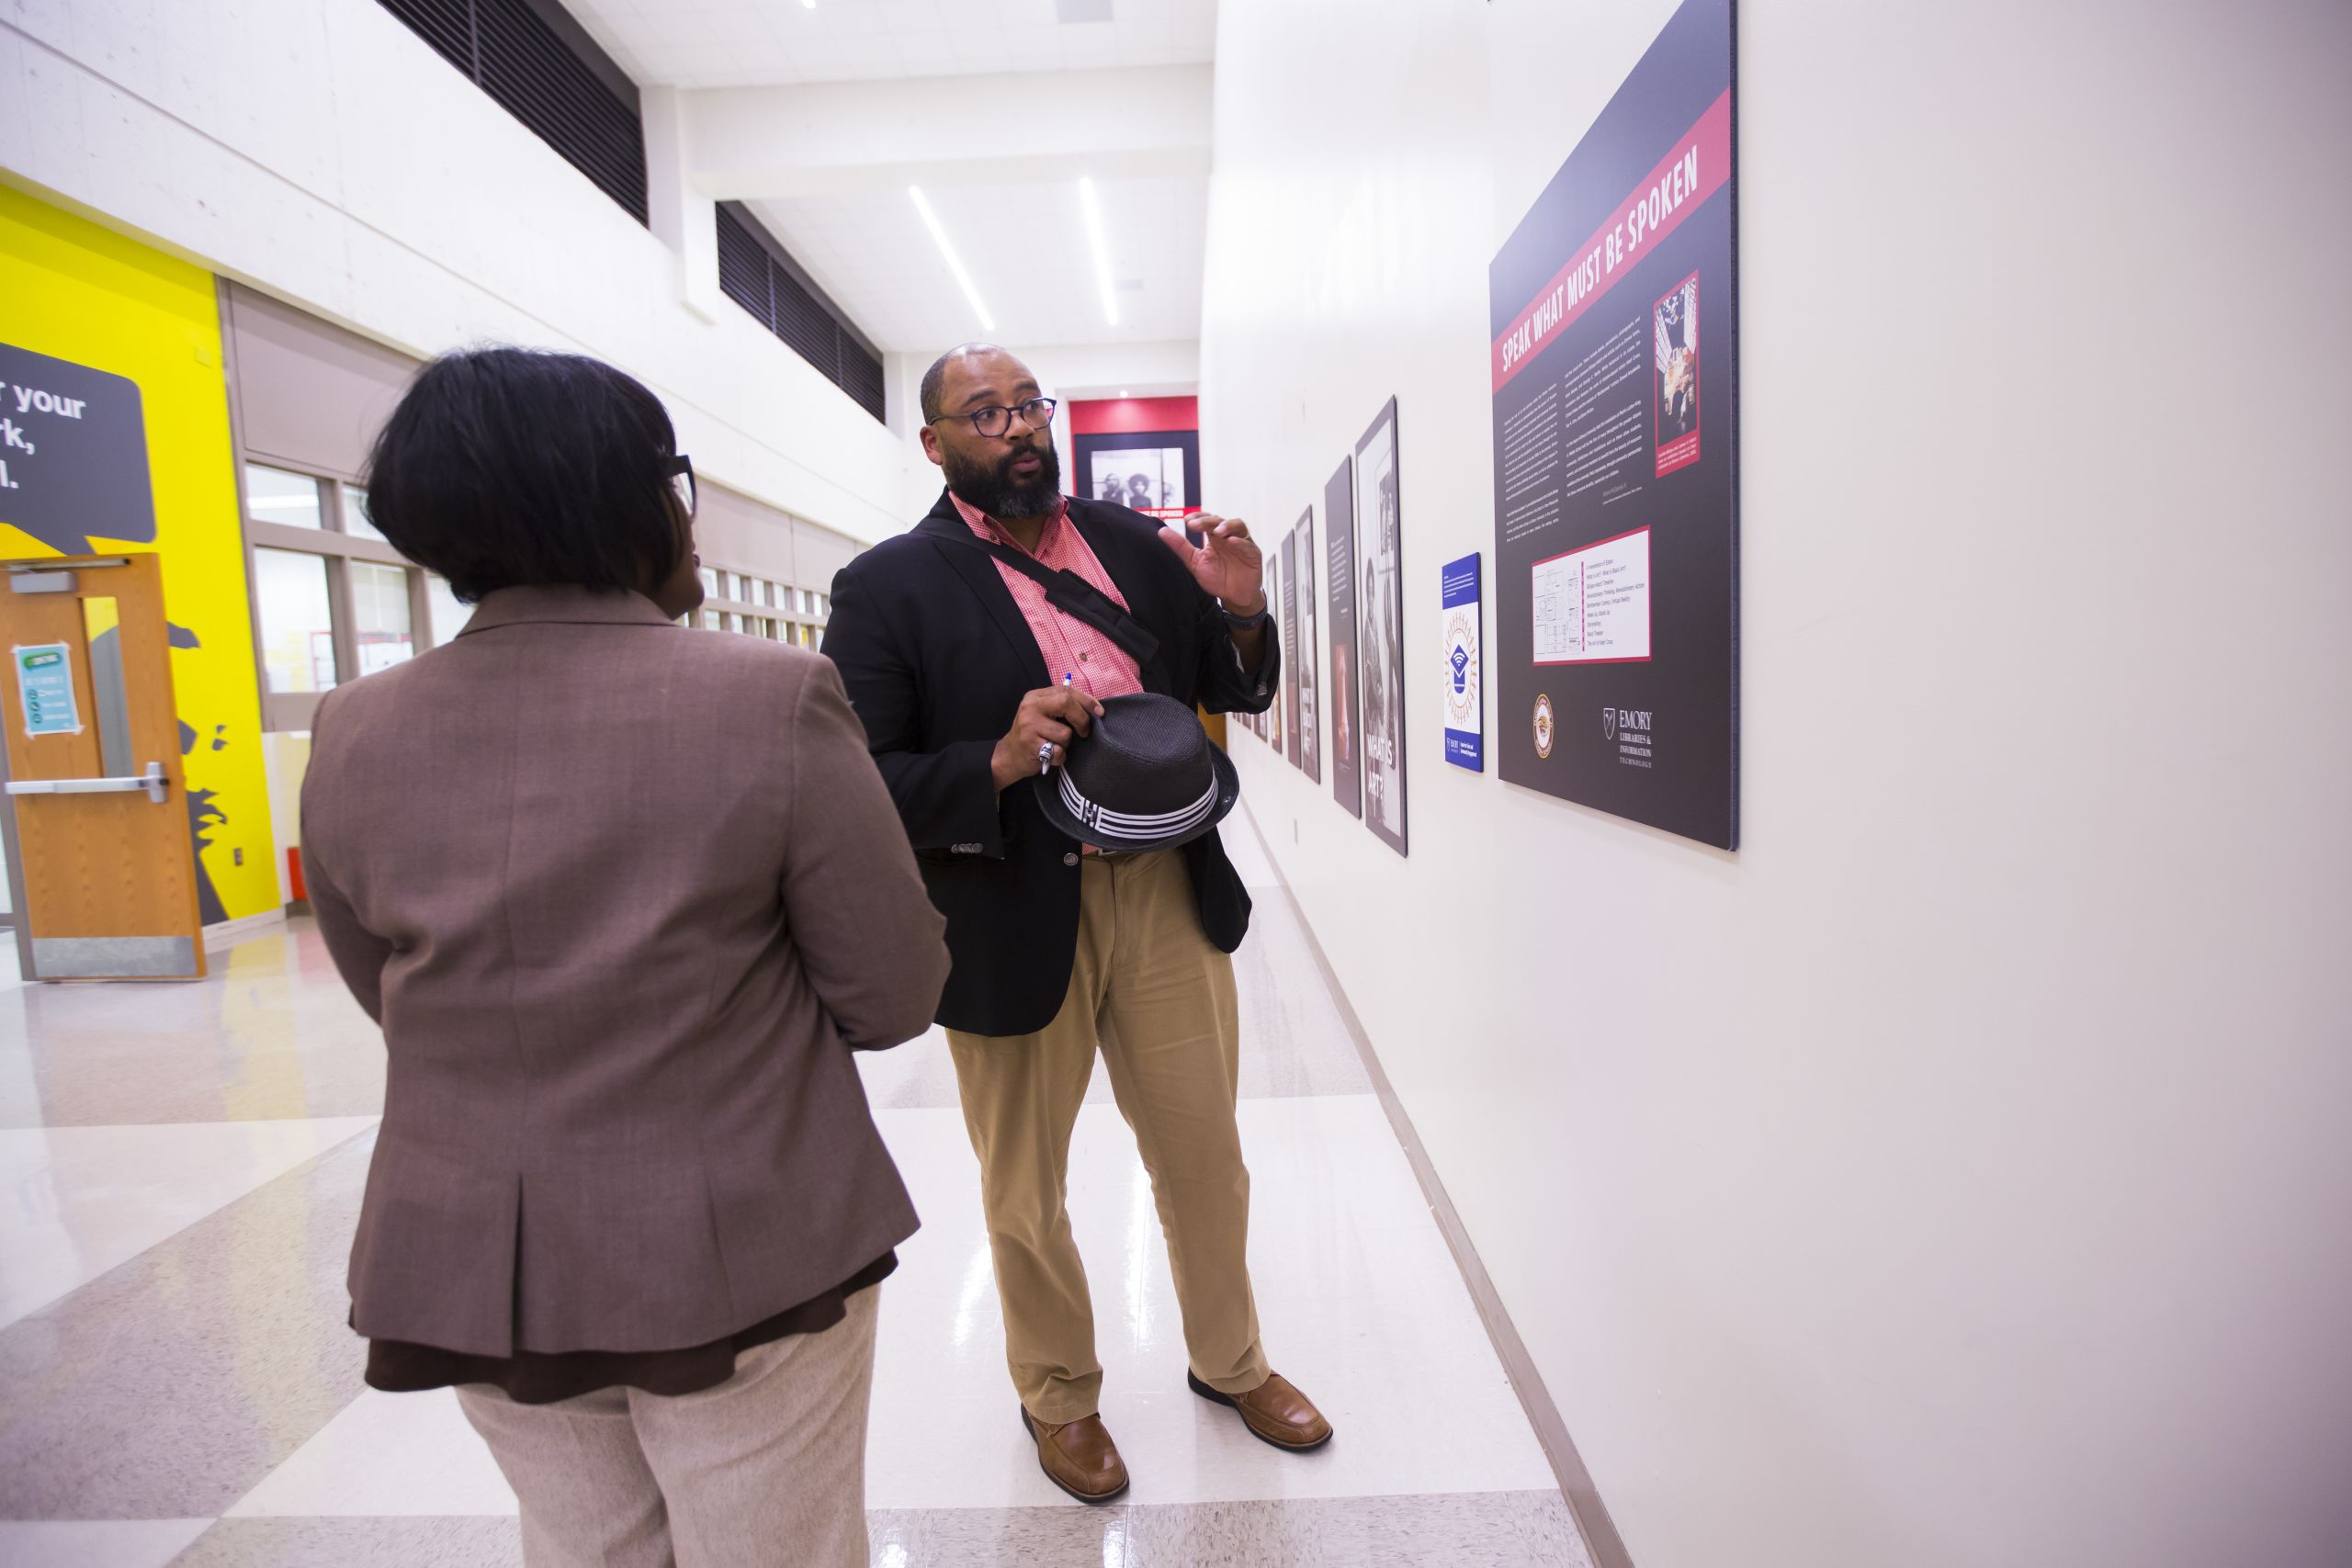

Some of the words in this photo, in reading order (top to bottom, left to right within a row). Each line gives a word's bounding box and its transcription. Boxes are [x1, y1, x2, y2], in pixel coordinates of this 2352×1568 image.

[1502, 318, 1532, 372] SPEAK
[1532, 284, 1564, 343] WHAT
[1566, 244, 1601, 310] MUST
[1606, 222, 1623, 274] BE
[1627, 144, 1697, 252] SPOKEN
[13, 384, 87, 420] your
[0, 417, 36, 455] k,
[1620, 709, 1652, 730] EMORY
[1366, 733, 1385, 762] WHAT
[1385, 738, 1393, 766] IS
[1620, 732, 1645, 744] LIBRARIES
[1646, 735, 1652, 745] &
[1620, 744, 1652, 758] INFORMATION
[1620, 756, 1652, 769] TECHNOLOGY
[1368, 771, 1384, 800] ART?
